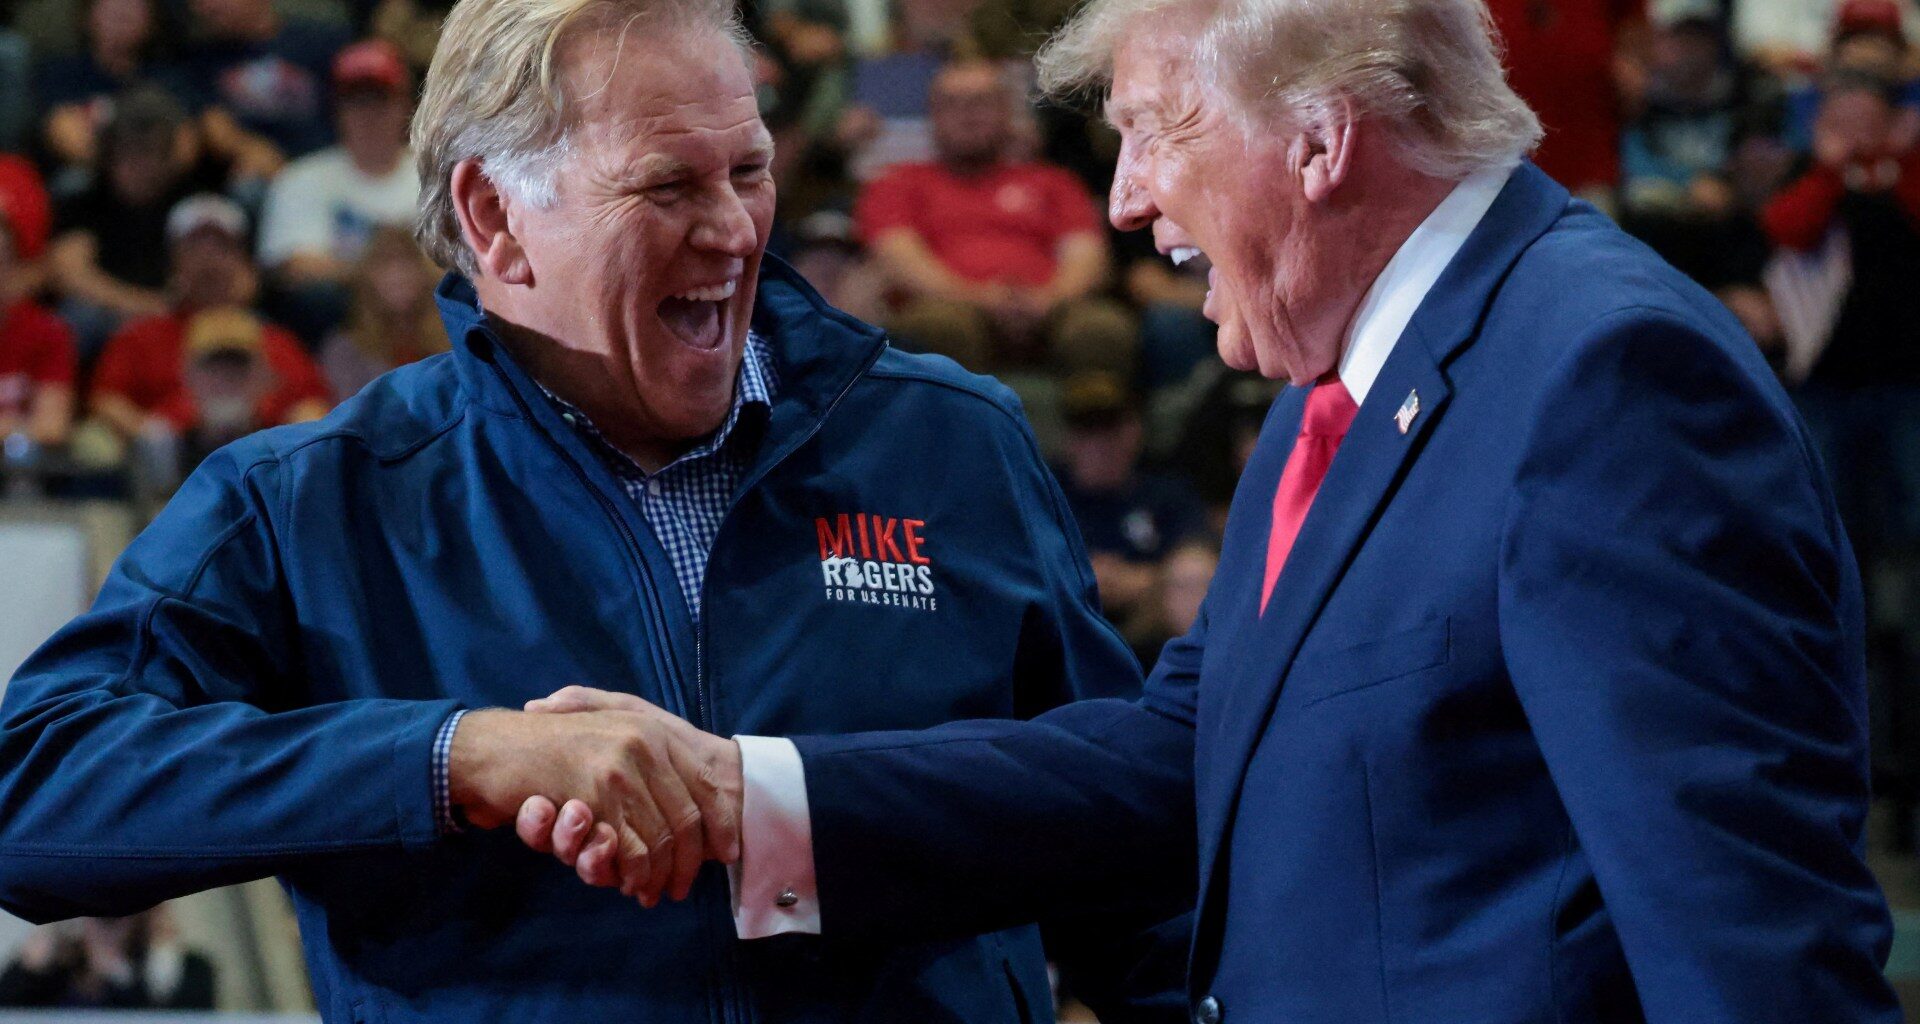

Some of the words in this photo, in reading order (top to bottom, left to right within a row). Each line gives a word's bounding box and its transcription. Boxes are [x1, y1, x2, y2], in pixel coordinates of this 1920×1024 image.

[815, 512, 931, 565] MIKE
[826, 588, 856, 601] FOR
[861, 590, 880, 605] U.S.
[883, 592, 937, 611] SENATE
